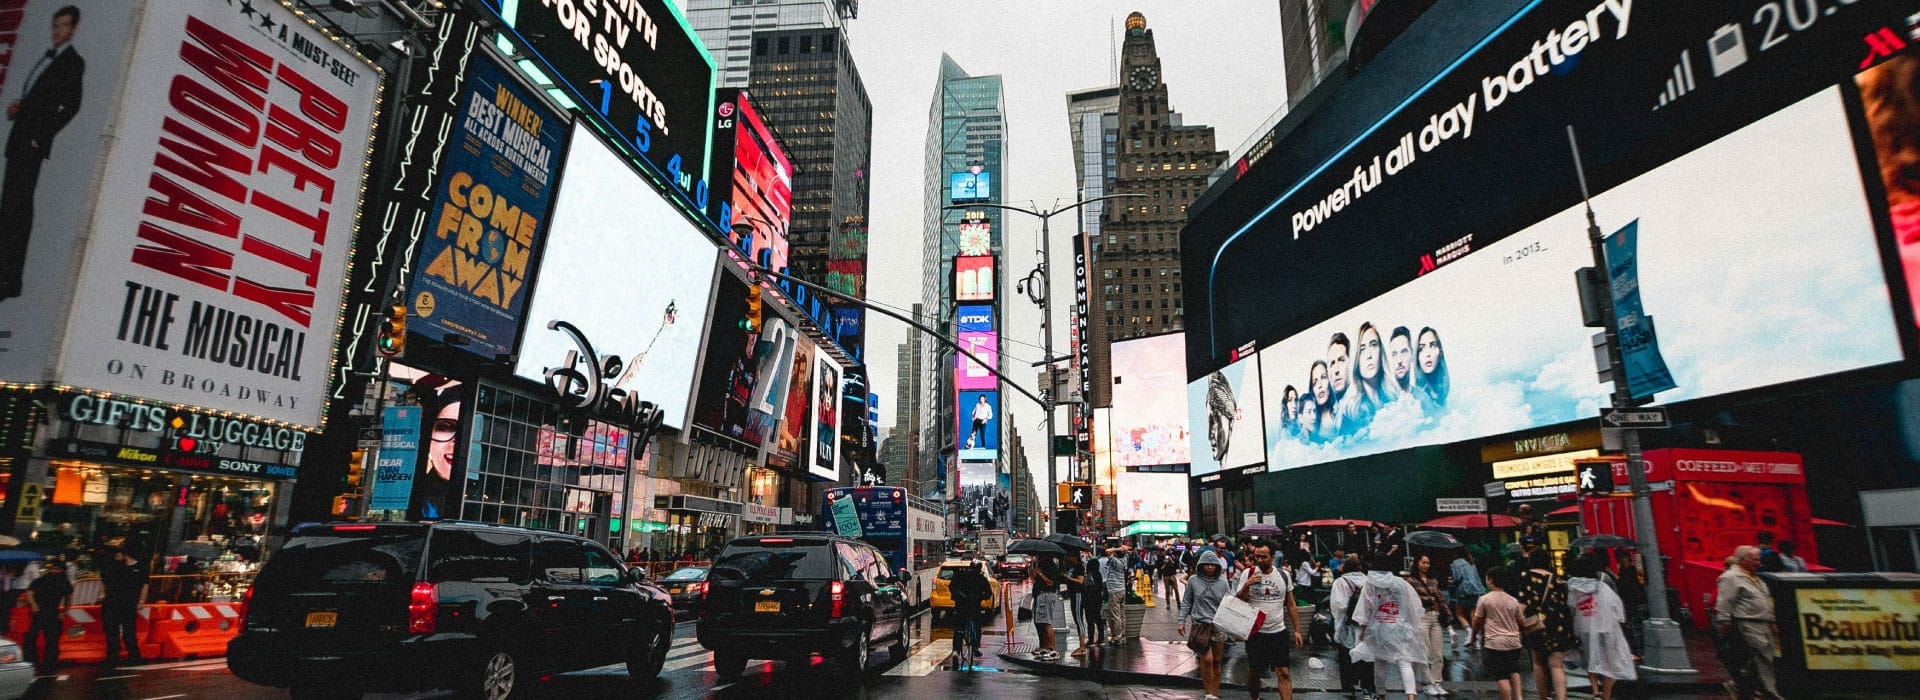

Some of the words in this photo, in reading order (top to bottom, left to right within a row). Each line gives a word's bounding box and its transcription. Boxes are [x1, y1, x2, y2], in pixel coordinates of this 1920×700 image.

[278, 24, 288, 42] A
[602, 1, 630, 49] TV
[541, 0, 590, 51] OR
[593, 33, 669, 136] SPORTS.
[468, 91, 504, 135] BEST
[502, 117, 551, 174] MUSICAL
[495, 83, 543, 139] WINNER!
[718, 119, 732, 129] LG
[1292, 156, 1382, 240] Powerful
[1385, 132, 1415, 175] all
[1419, 92, 1476, 139] day
[1482, 0, 1632, 112] battery
[131, 15, 274, 292] WOMAN
[464, 117, 479, 135] ALL
[478, 126, 505, 153] ACROSS
[523, 160, 548, 186] AMERICA
[233, 62, 349, 329] PRETTY
[449, 172, 538, 249] COME
[437, 202, 531, 282] FROM
[424, 244, 522, 310] AWAY
[117, 280, 180, 350] THE
[182, 300, 305, 381] MUSICAL
[968, 315, 990, 324] TDK
[1076, 254, 1089, 391] COMMUNICATE
[107, 359, 148, 380] ON
[161, 369, 301, 410] BROADWAY
[543, 319, 665, 461] Disney
[750, 317, 799, 420] 21
[69, 395, 167, 433] GIFTS
[188, 413, 307, 452] LUGGAGE
[1514, 432, 1570, 454] INVICTA
[1610, 413, 1630, 422] ONE
[1638, 412, 1658, 422] WAY
[117, 448, 158, 463] Nikon
[194, 441, 224, 456] NY
[219, 459, 262, 473] SONY
[379, 459, 403, 467] DEAR
[1676, 459, 1737, 473] COFFEED
[698, 512, 726, 528] FOREVER
